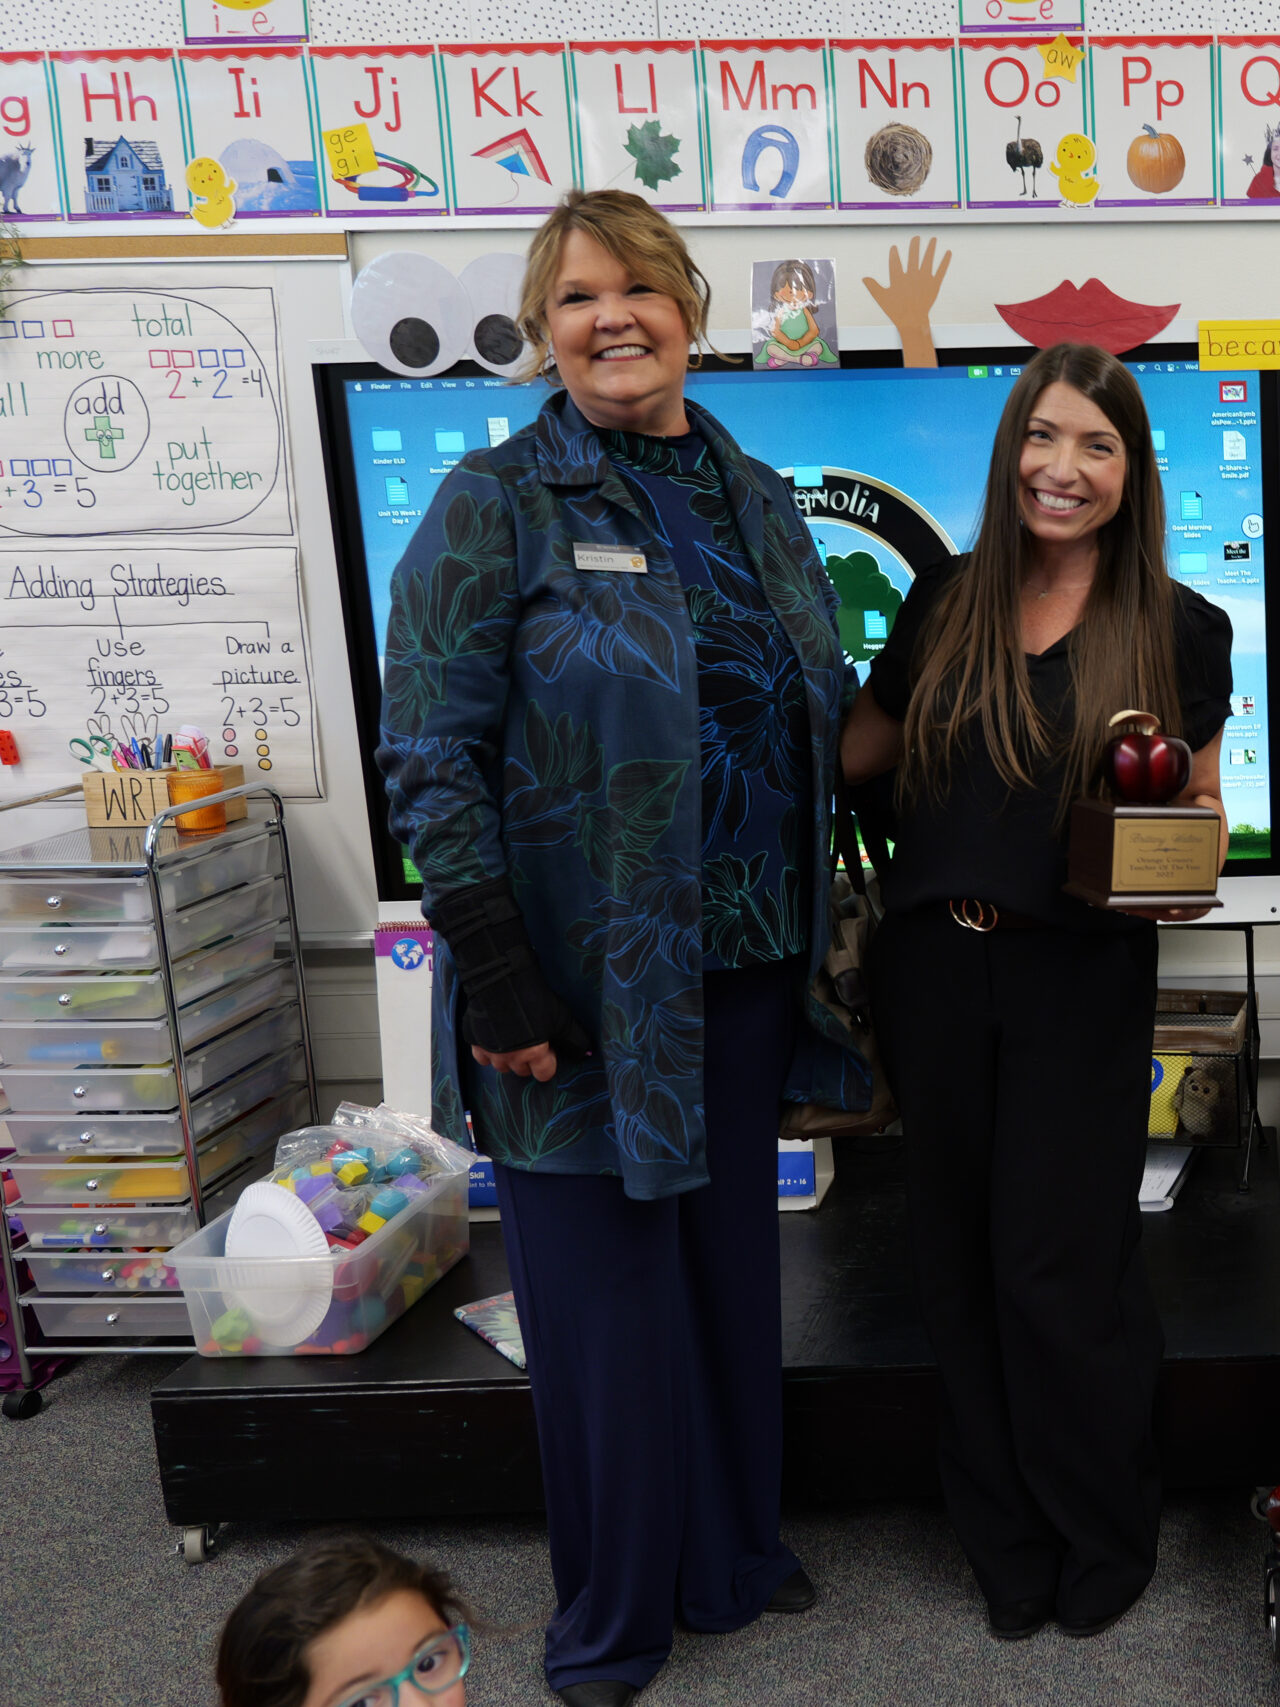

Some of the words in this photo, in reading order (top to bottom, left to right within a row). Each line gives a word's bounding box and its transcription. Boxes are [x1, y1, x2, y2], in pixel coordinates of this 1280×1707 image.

[1046, 48, 1075, 70] aw
[80, 71, 158, 122] Hh
[228, 67, 262, 118] Ii
[354, 67, 402, 132] Jj
[471, 67, 544, 118] Kk
[615, 62, 658, 114] Ll
[719, 60, 817, 111] Mm
[858, 58, 932, 109] Nn
[984, 56, 1061, 108] Oo
[1121, 55, 1185, 120] Pp
[330, 127, 357, 154] ge
[336, 153, 361, 178] gi
[132, 303, 192, 338] total
[37, 350, 104, 370] more
[74, 381, 125, 416] add
[168, 426, 213, 470] put
[152, 461, 263, 506] together
[577, 554, 614, 563] Kristin
[9, 565, 95, 611] Adding
[110, 563, 228, 607] Strategies
[96, 638, 145, 659] Use
[226, 636, 271, 656] Draw
[281, 641, 294, 654] a
[88, 657, 157, 695] fingers
[221, 665, 299, 694] picture
